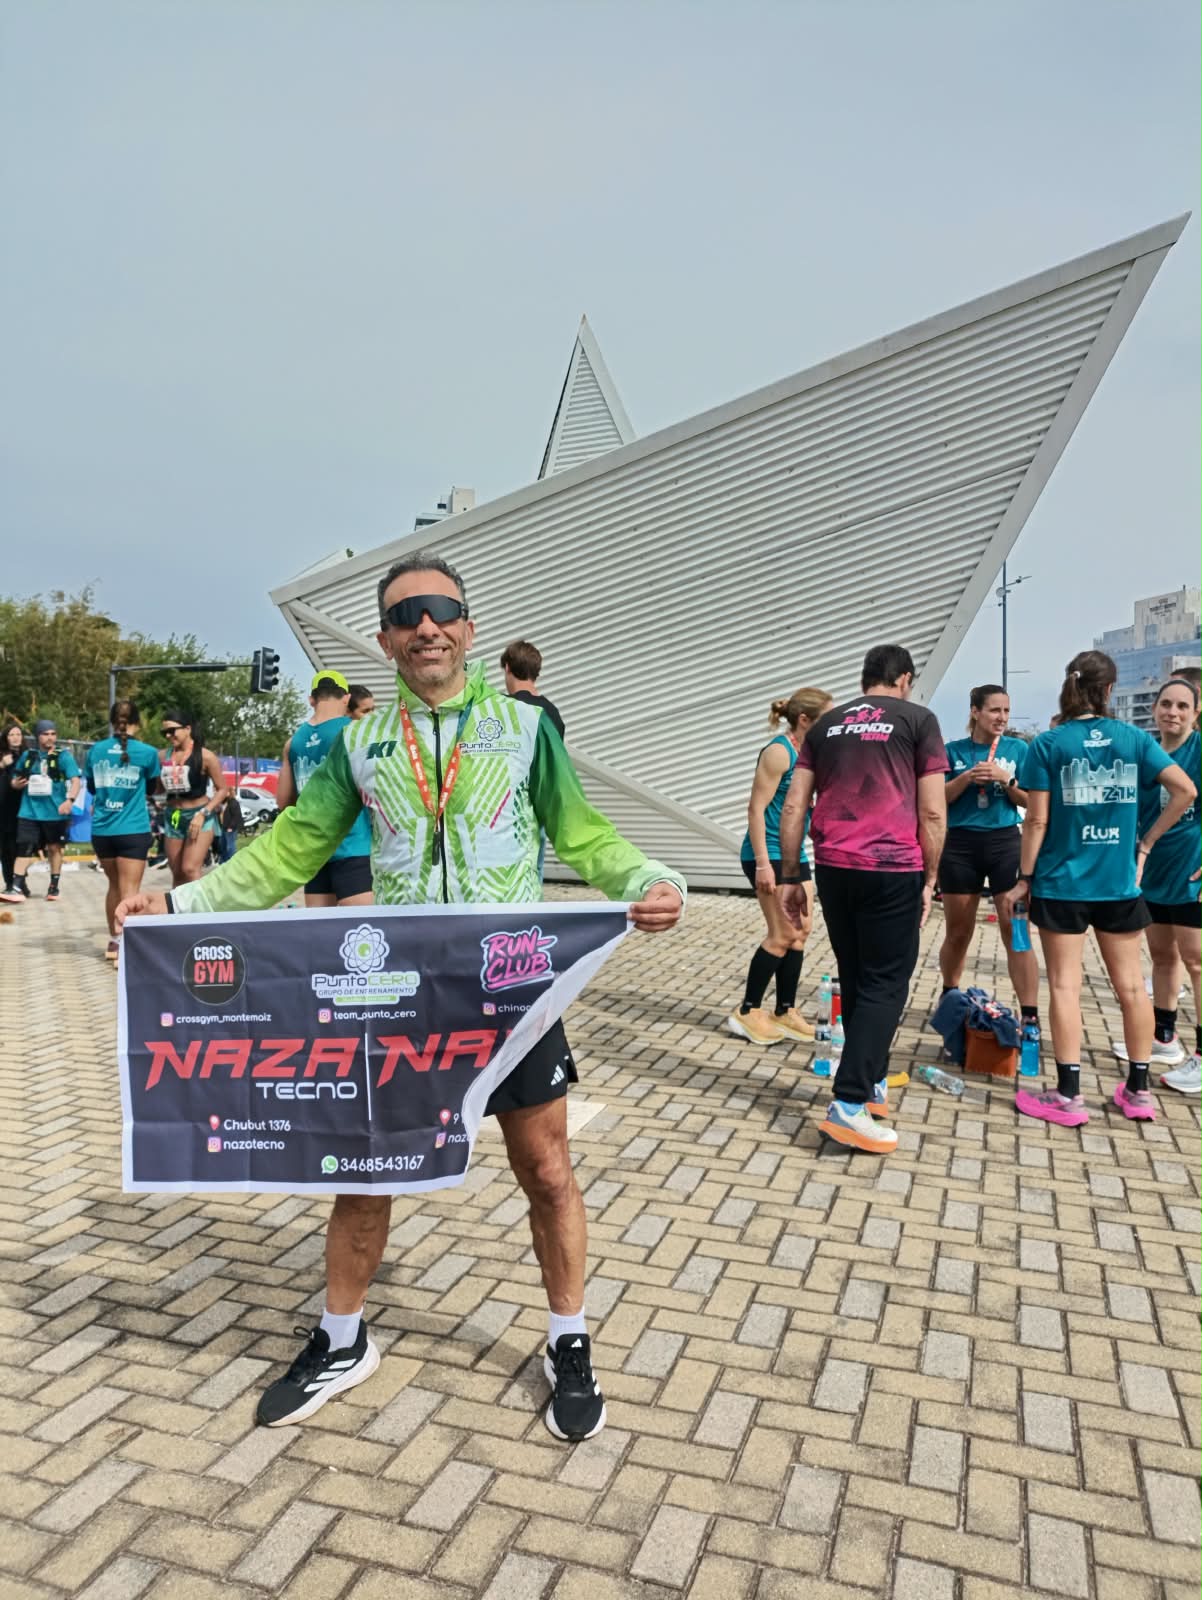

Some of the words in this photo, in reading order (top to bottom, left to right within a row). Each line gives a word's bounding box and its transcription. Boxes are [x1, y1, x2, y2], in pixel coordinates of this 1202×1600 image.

[826, 725, 845, 738] DE
[845, 722, 894, 735] FONDO
[193, 945, 233, 961] CROSS
[488, 930, 538, 961] RUN
[193, 960, 235, 984] GYM
[486, 953, 550, 982] CLUB
[318, 988, 343, 997] GRUPO
[343, 988, 354, 996] DE
[354, 986, 414, 996] ENTRENAMIENTO
[333, 1009, 417, 1021] team_punto_cero
[144, 1037, 360, 1091] NAZA
[376, 1028, 513, 1089] NA
[255, 1082, 358, 1100] TECNO
[223, 1118, 267, 1131] Chubut
[268, 1119, 292, 1132] 1376
[223, 1138, 286, 1150] nazatecno
[340, 1155, 425, 1172] 3468543167
